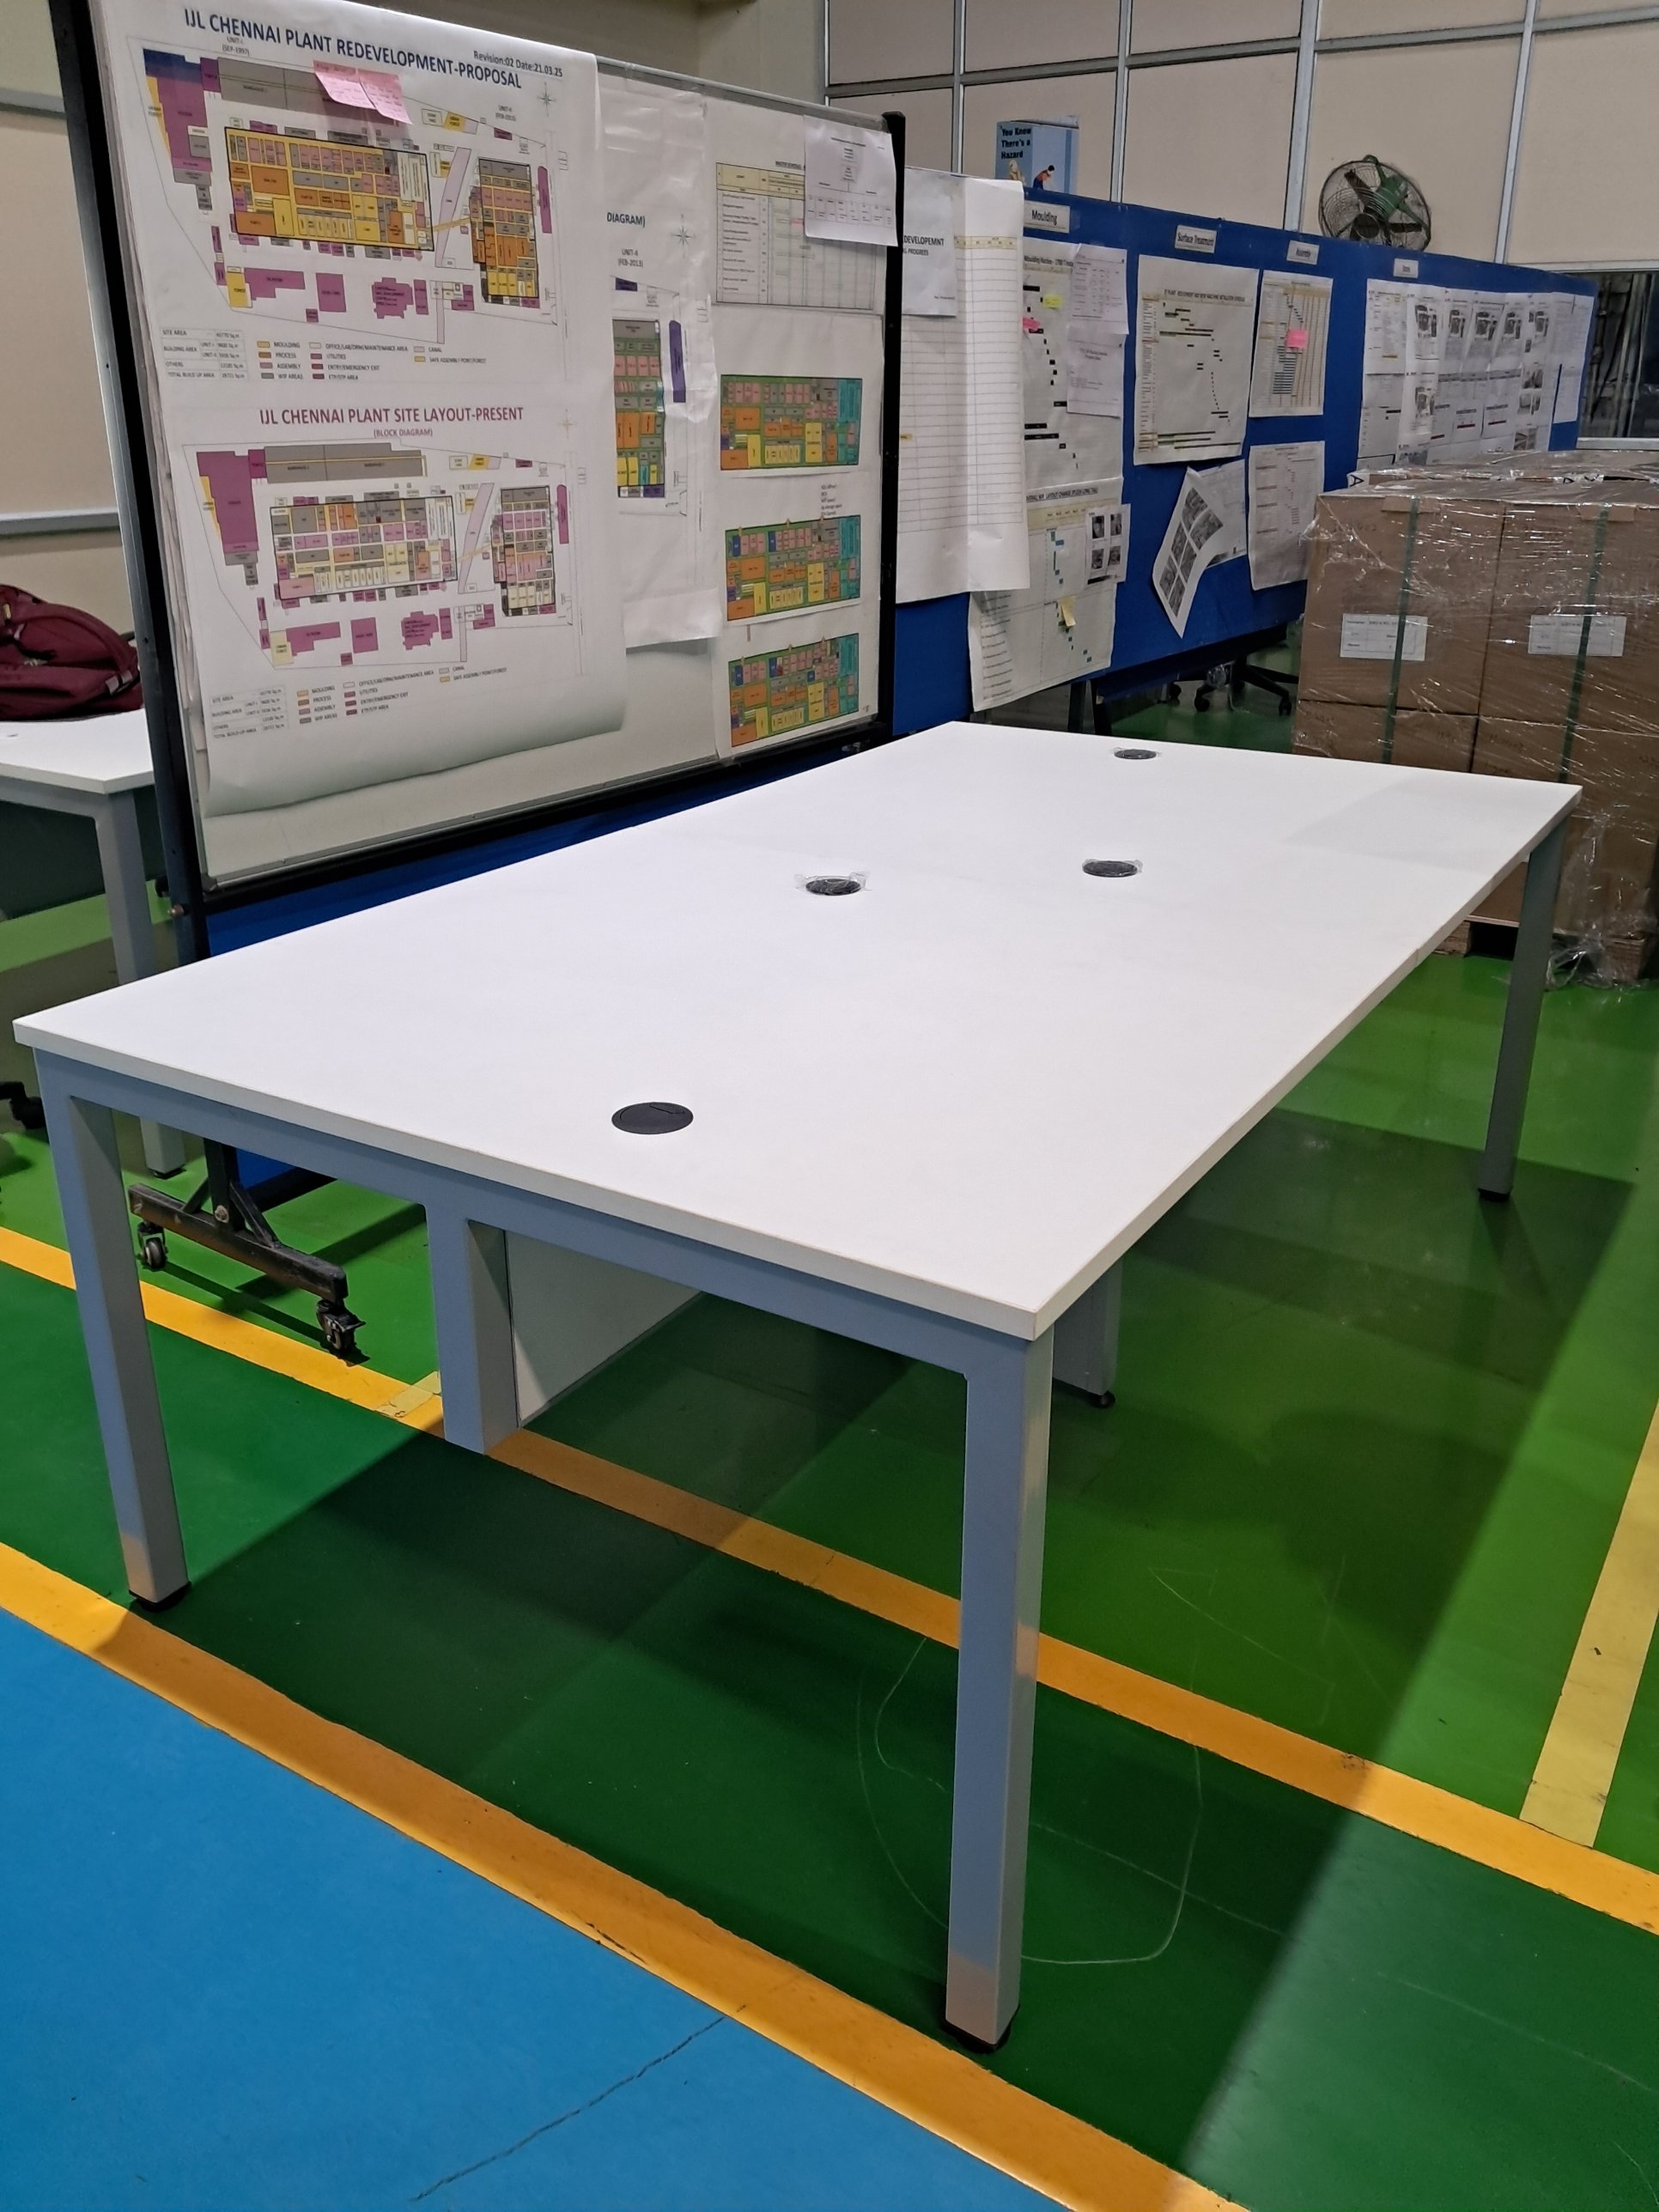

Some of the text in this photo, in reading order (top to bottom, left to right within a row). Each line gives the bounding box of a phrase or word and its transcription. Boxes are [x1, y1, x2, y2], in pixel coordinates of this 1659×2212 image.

[184, 8, 205, 29] IJL
[210, 14, 282, 44] CHENNAI
[285, 28, 332, 53] PLANT
[337, 38, 522, 88] REDEVELOPMENT-PROPOSAL
[473, 49, 563, 78] Revision:02 Date:21.03.25
[1001, 127, 1033, 137] You Know
[1000, 138, 1025, 148] There's
[1000, 150, 1024, 160] Hazard
[606, 211, 646, 228] DIAGRAM)
[1031, 209, 1058, 226] Moulding
[1177, 232, 1214, 246] Surface Treatment
[259, 406, 524, 425] IJL CHENNAI PLANT SITE LAYOUT-PRESENT
[374, 427, 433, 438] (BLOCK DIAGRAM)
